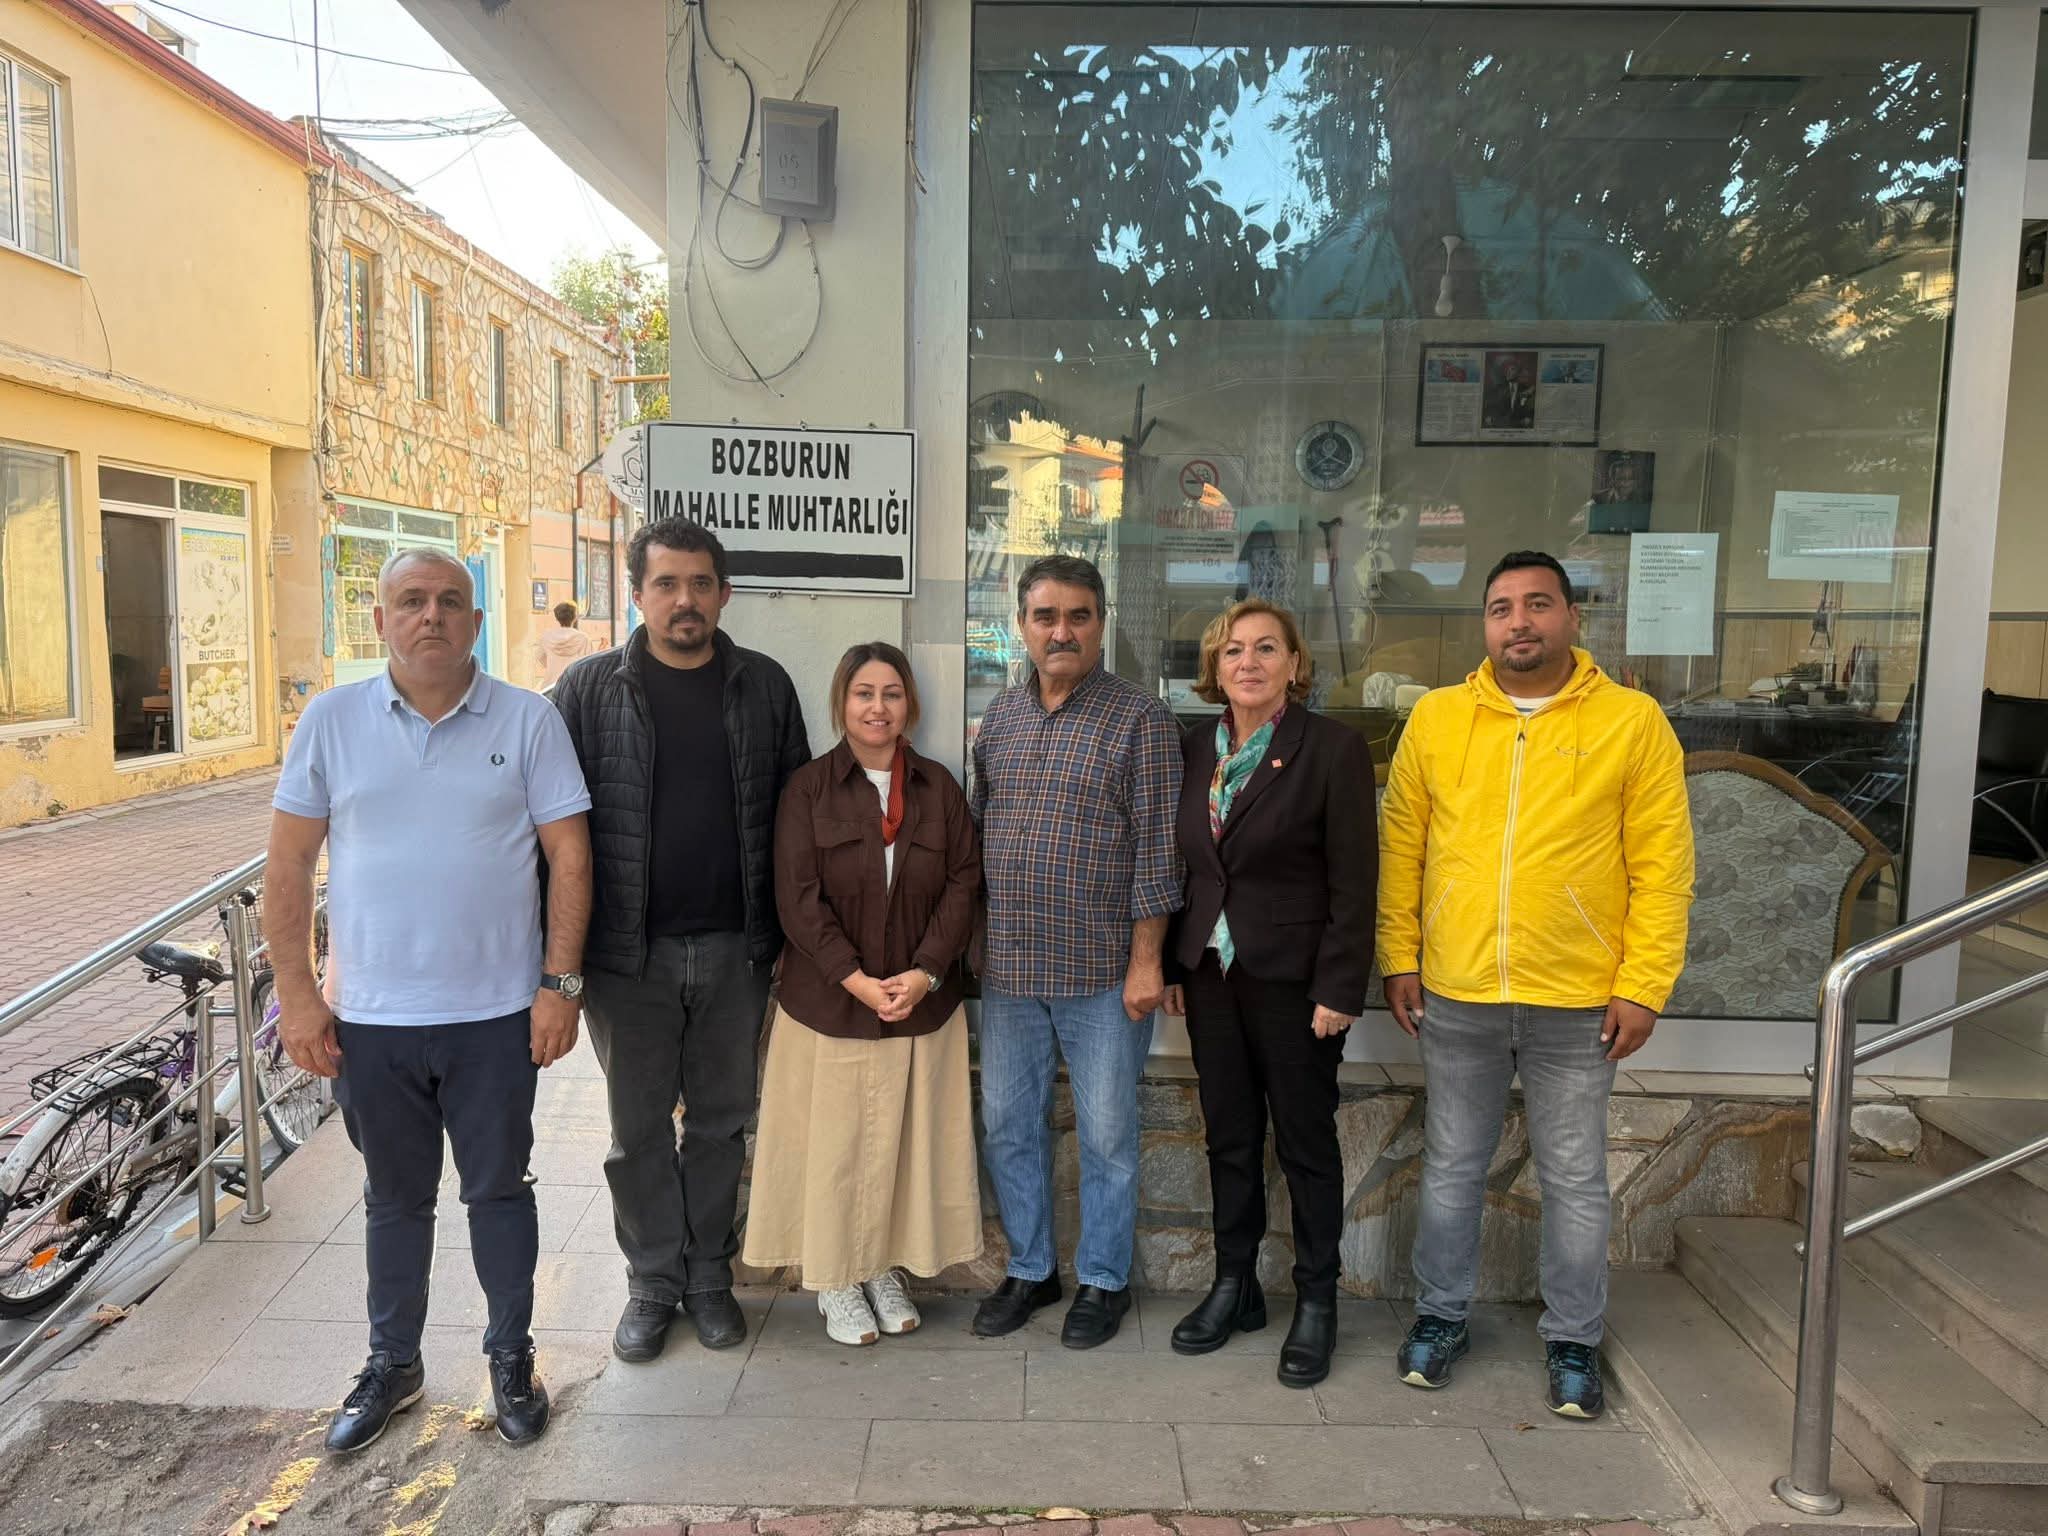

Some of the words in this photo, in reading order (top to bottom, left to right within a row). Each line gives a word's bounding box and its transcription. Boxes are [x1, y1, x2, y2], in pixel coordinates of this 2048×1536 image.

[712, 438, 850, 480] BOZBURUN
[654, 490, 760, 530] MAHALLE
[768, 489, 908, 535] MUHTARLIĞI
[199, 649, 236, 661] BUTCHER
